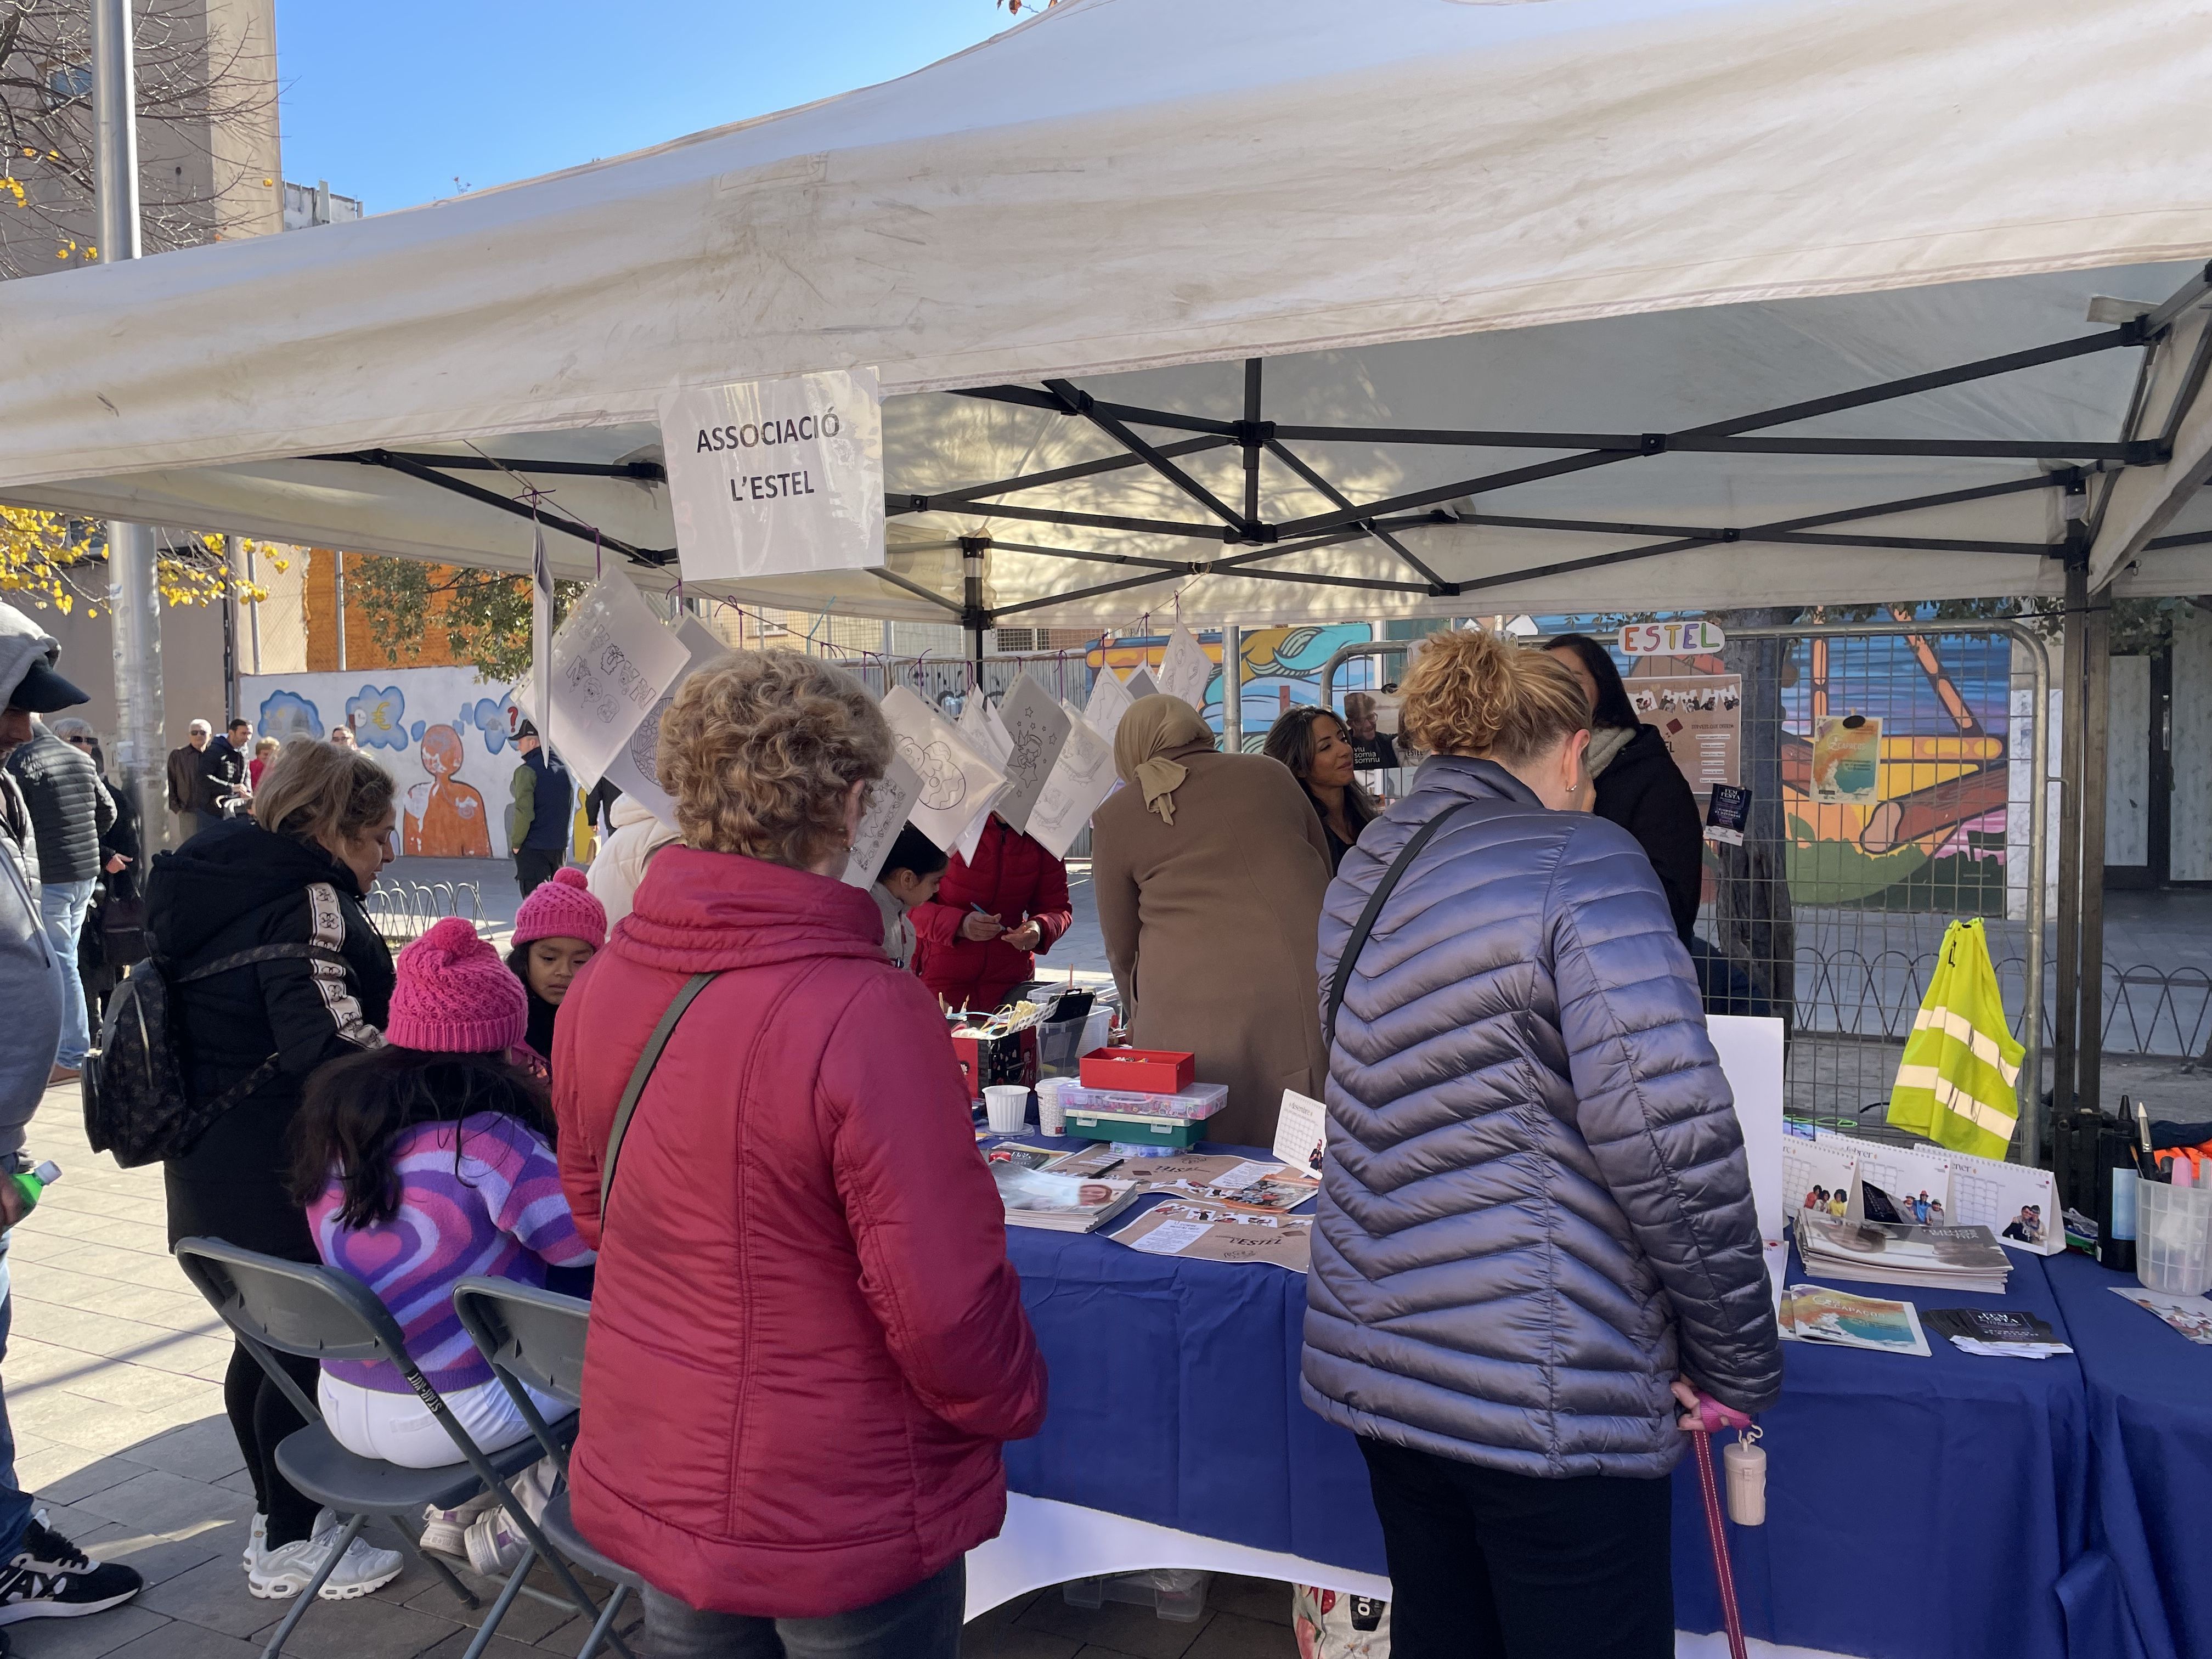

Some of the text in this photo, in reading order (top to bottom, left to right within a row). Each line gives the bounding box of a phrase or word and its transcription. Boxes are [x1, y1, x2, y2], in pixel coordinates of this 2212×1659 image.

[697, 407, 840, 453] ASSOCIACIÓ
[731, 470, 815, 501] L'ESTEL
[1625, 623, 1720, 652] ESTEL
